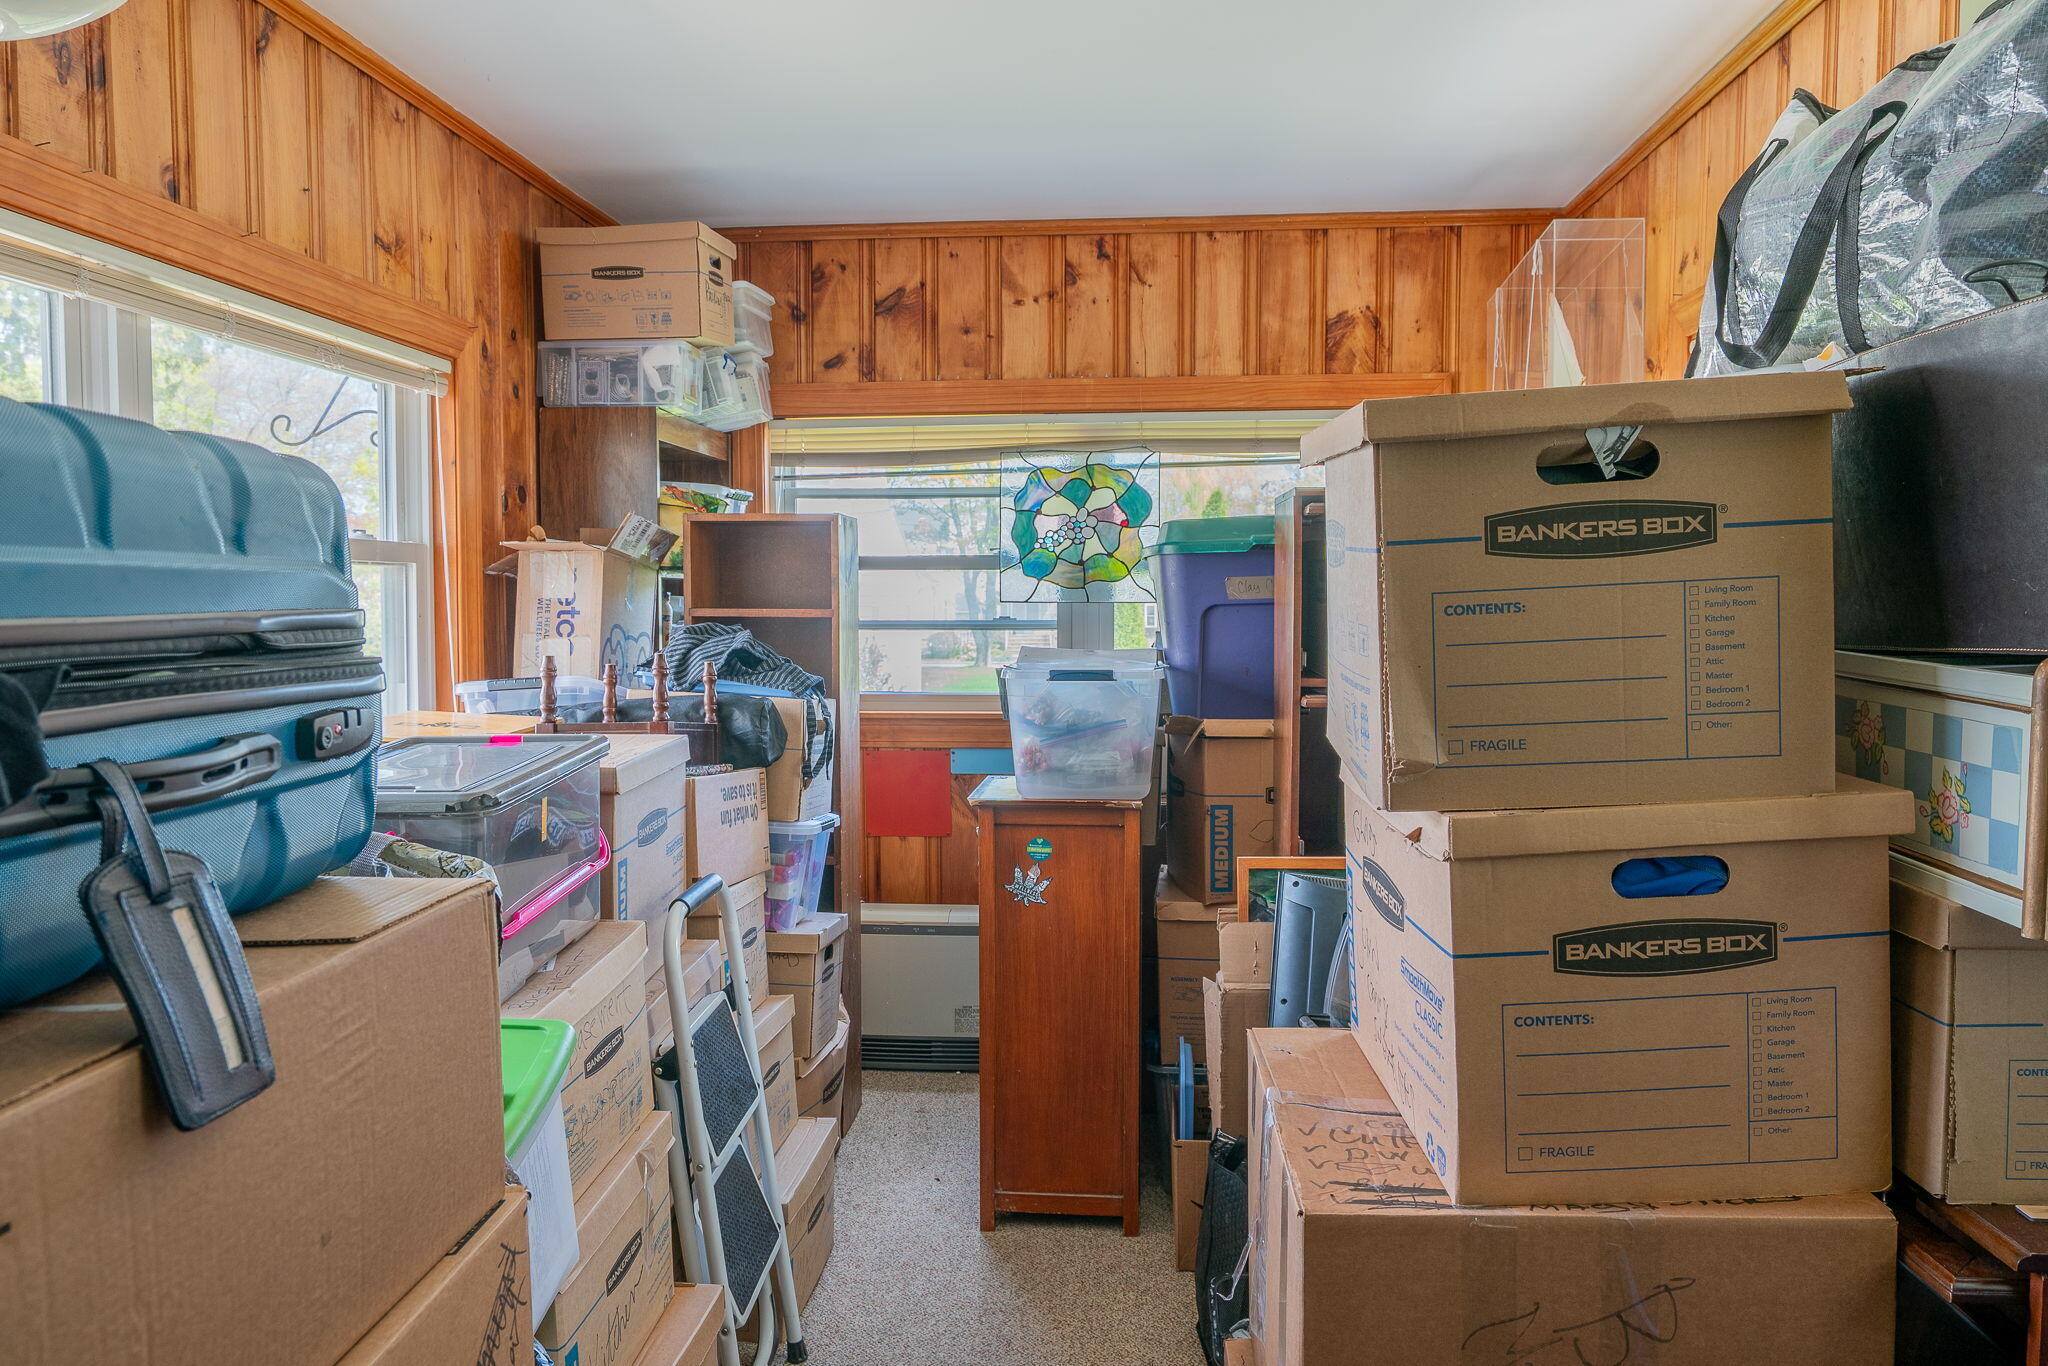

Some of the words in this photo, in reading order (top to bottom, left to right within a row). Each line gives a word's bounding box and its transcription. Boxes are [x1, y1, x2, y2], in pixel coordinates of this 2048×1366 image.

[594, 269, 626, 277] BANKERS
[1497, 518, 1636, 543] BANKERS
[1642, 514, 1706, 535] BOX
[1704, 586, 1728, 594] Living
[1704, 600, 1730, 608] Family
[1444, 602, 1526, 617] CONTENTS:
[1704, 614, 1735, 622] Kitchen
[1705, 629, 1735, 638] Garage
[1705, 642, 1745, 651] Basement
[1706, 672, 1734, 680] Master
[1706, 686, 1744, 694] Bedroom
[1706, 700, 1744, 708] Bedroom
[1470, 738, 1527, 752] FRAGILE
[1214, 809, 1228, 888] MEDIUM
[1364, 866, 1388, 906] BANKERS
[1388, 894, 1402, 920] BOX
[1566, 938, 1701, 961] BANKERS
[1707, 934, 1768, 954] BOX
[1400, 958, 1443, 1012] SmoothMove
[1767, 997, 1788, 1005] Living
[1416, 1000, 1443, 1040] CLASSIC
[1514, 1014, 1594, 1028] CONTENTS:
[1767, 1039, 1795, 1047] Garage
[586, 1042, 612, 1072] BANKERS
[611, 1032, 622, 1048] BOX
[1768, 1052, 1805, 1060] Basement
[1768, 1093, 1803, 1101] Bedroom
[1768, 1106, 1802, 1115] Bedroom
[1539, 1146, 1594, 1158] FRAGILE
[608, 1250, 632, 1288] BANKERS
